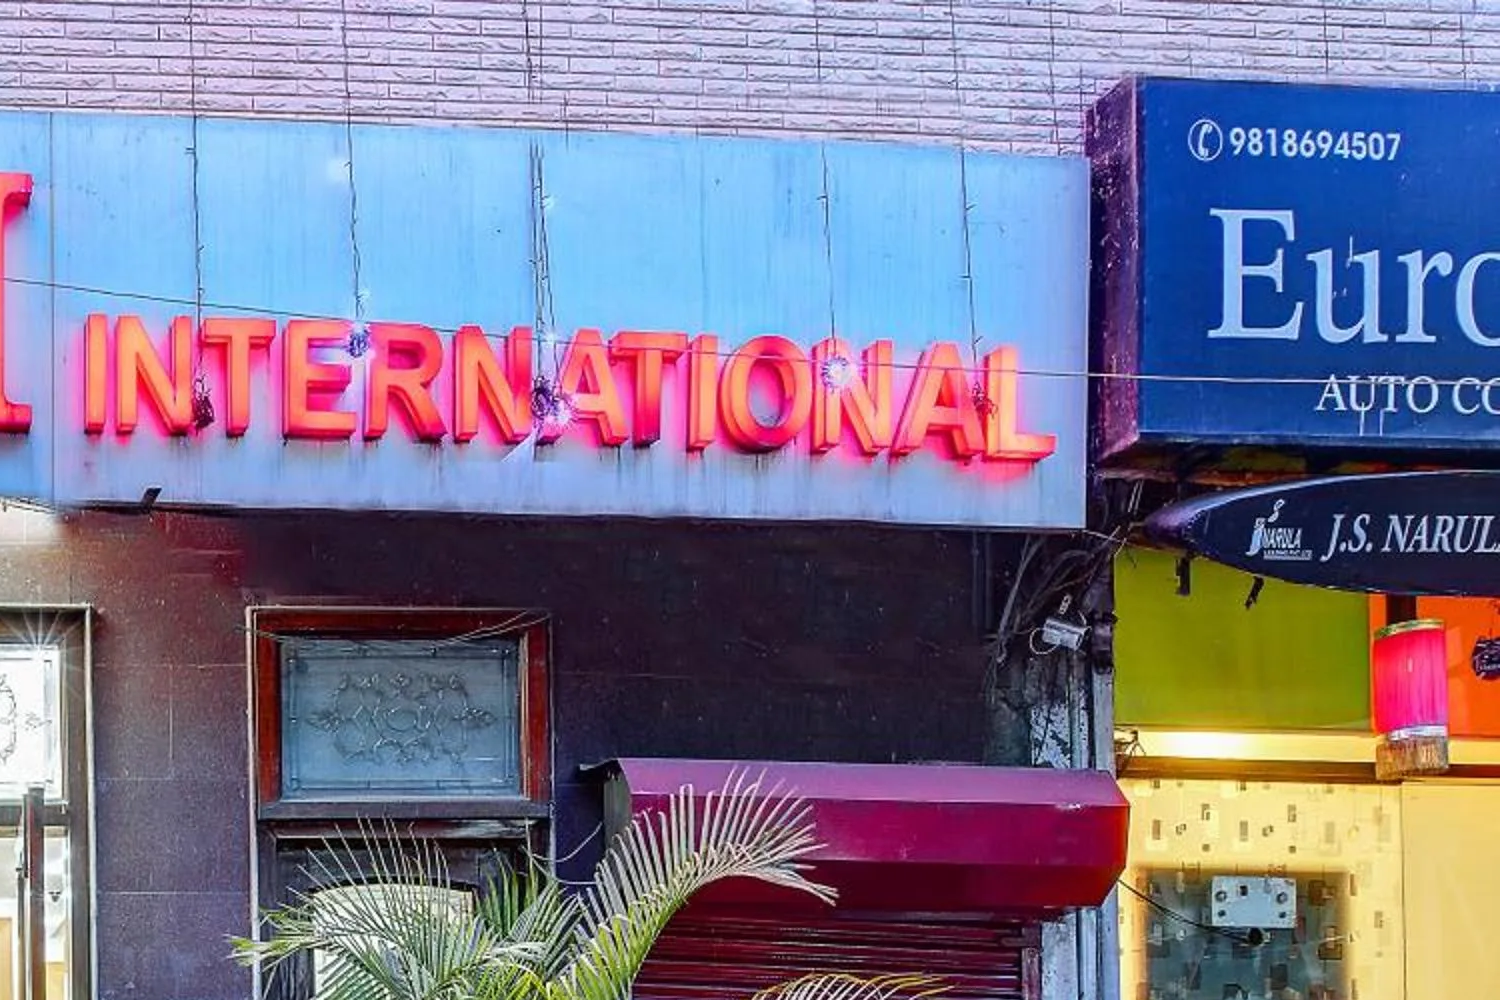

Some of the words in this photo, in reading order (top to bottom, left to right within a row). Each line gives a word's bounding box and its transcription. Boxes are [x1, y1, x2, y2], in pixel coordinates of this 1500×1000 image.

[1229, 126, 1402, 161] 9818694507
[82, 313, 1056, 463] INTERNATIONAL
[1315, 373, 1439, 414] AUTO
[1320, 513, 1373, 562] J.S.
[1381, 514, 1500, 553] NARUL
